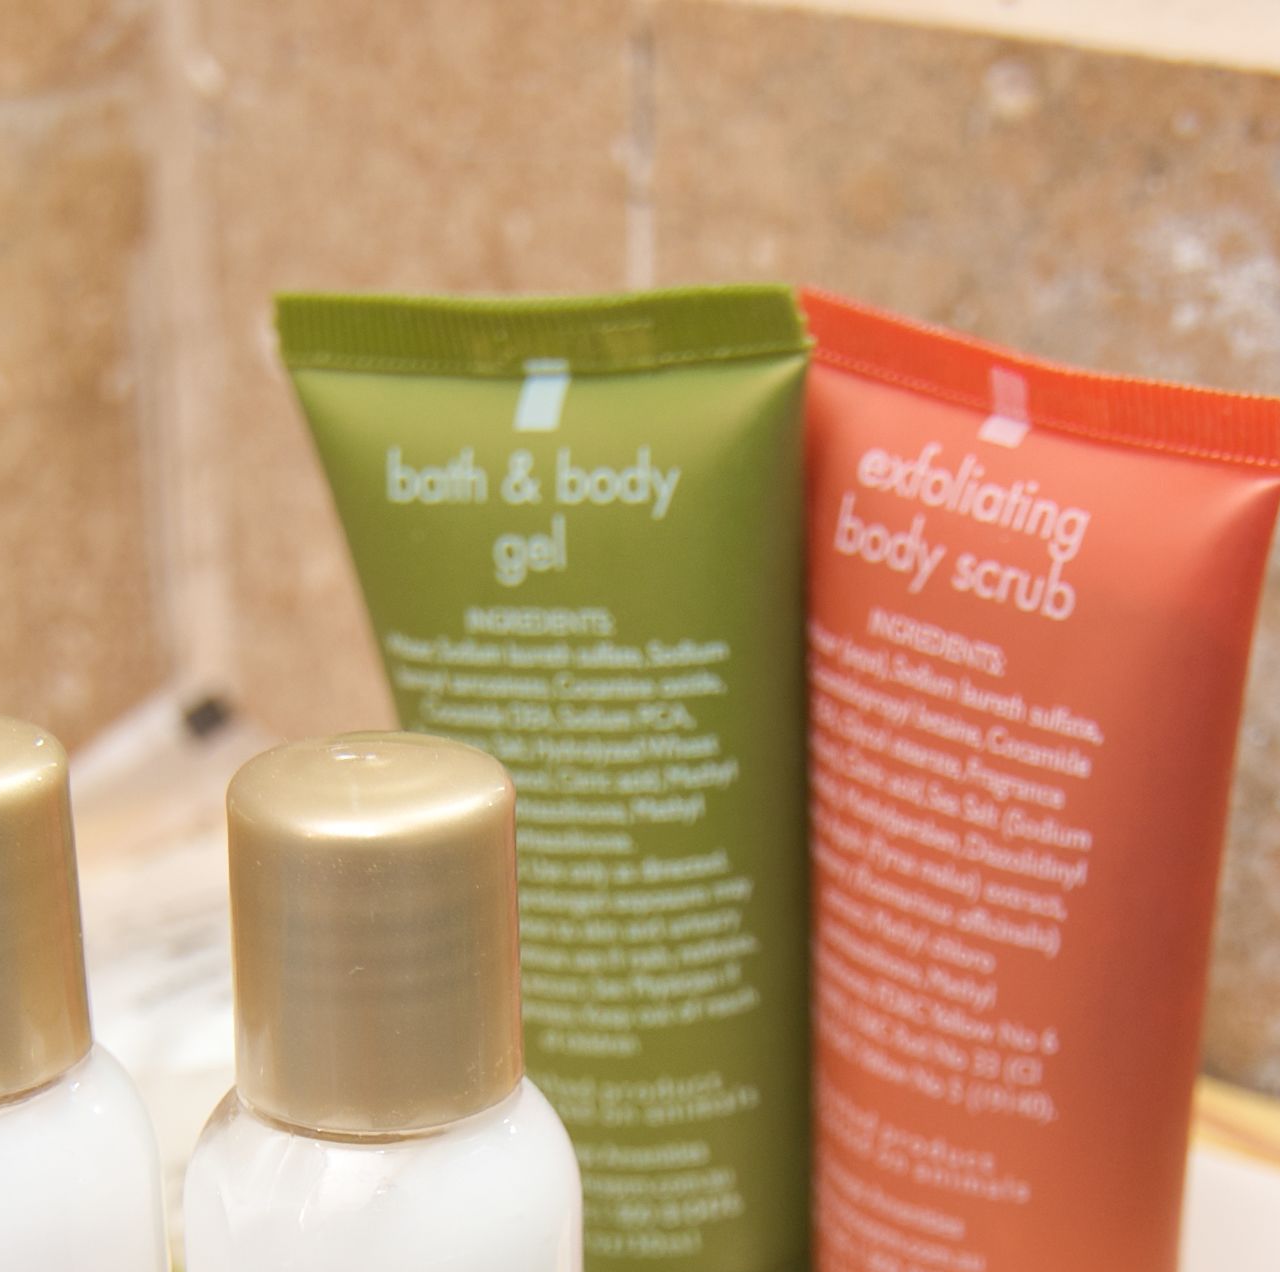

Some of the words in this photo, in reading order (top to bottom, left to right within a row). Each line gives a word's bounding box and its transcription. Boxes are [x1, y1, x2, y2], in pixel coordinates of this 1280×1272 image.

[386, 446, 487, 505] bath
[500, 449, 542, 505] &
[556, 446, 681, 519] body
[857, 441, 1091, 562] exfoliating
[493, 517, 568, 585] gel
[834, 490, 947, 594] body
[951, 551, 1076, 621] scrub
